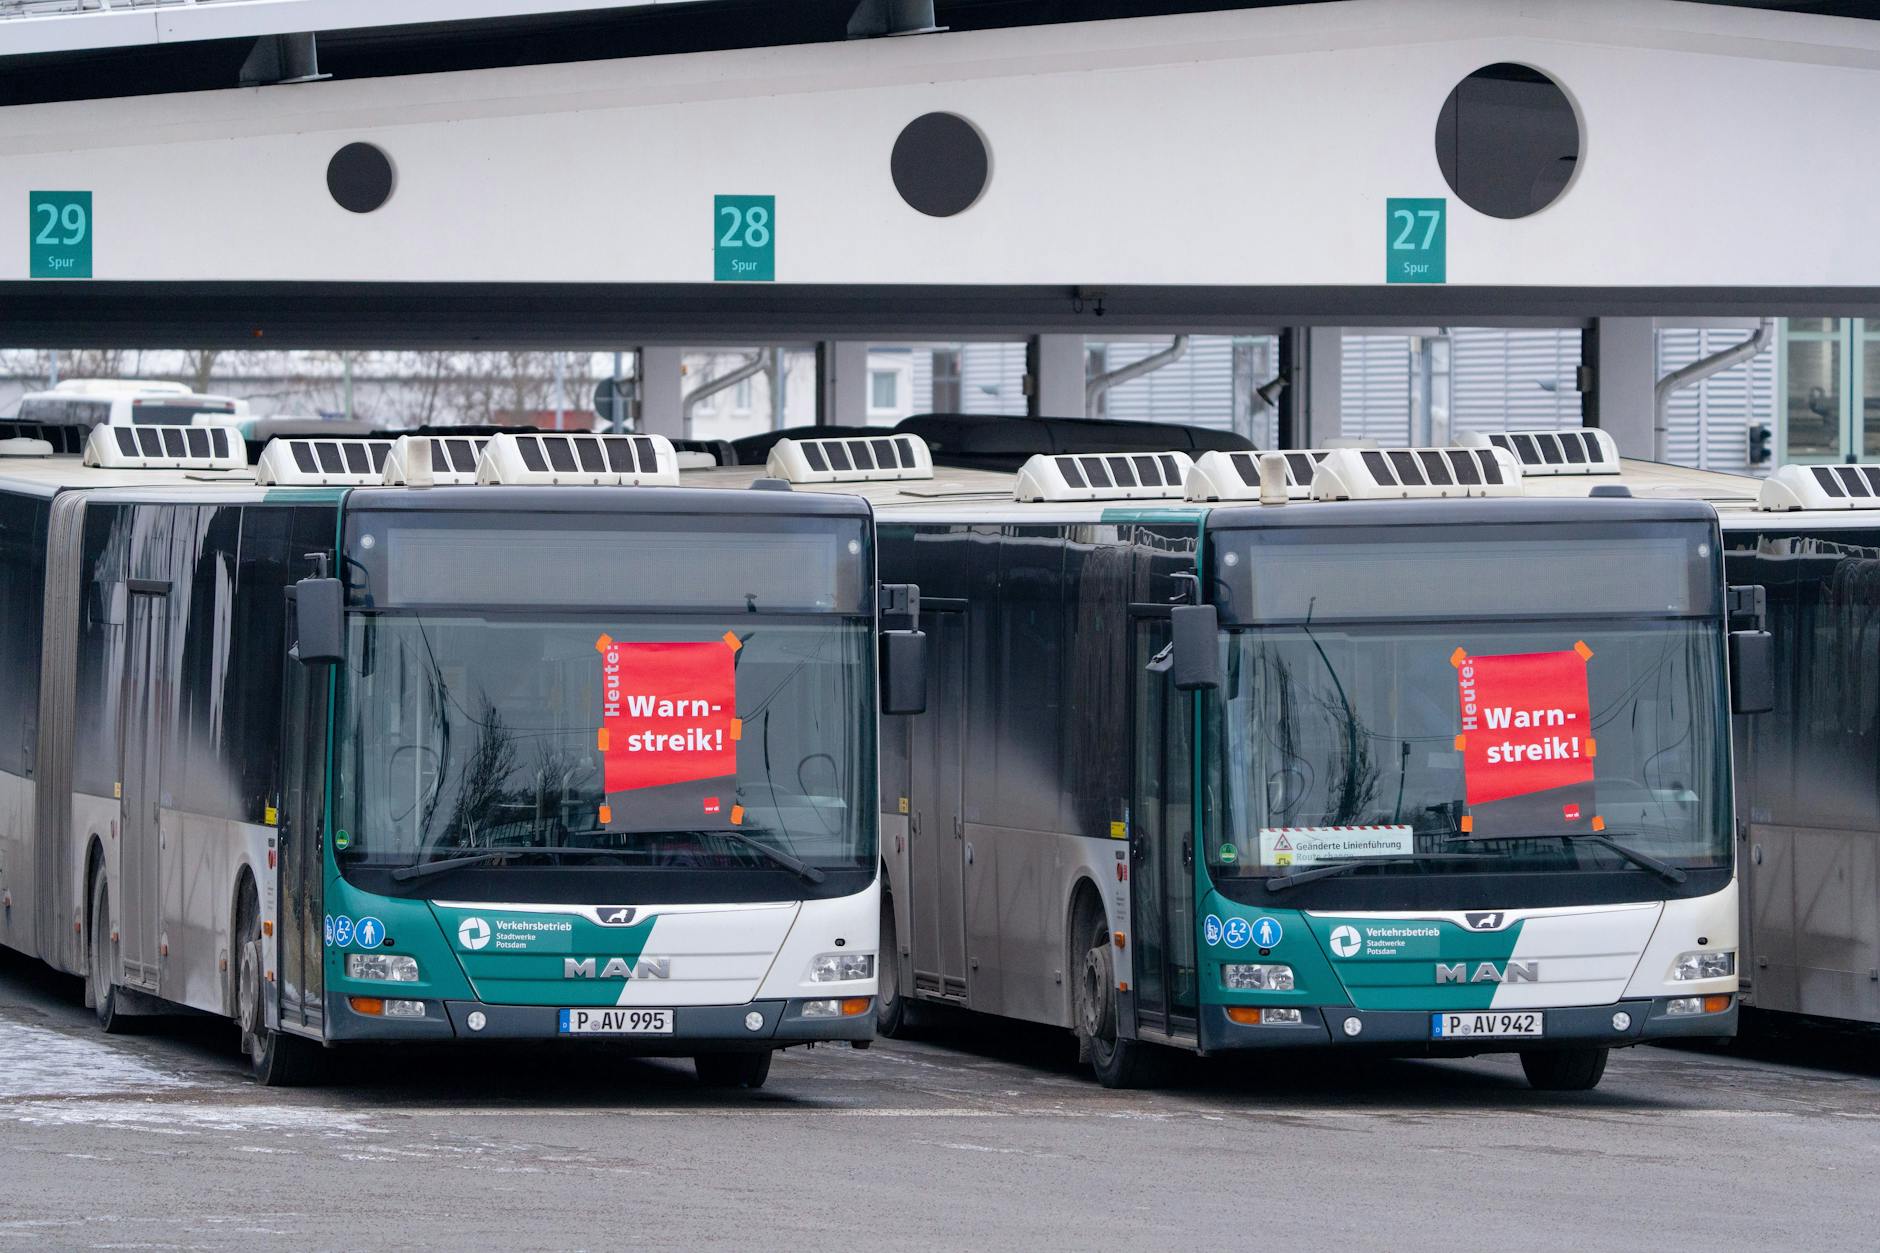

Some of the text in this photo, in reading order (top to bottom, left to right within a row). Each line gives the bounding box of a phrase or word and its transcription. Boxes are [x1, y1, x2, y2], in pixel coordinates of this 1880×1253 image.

[36, 203, 86, 245] 29
[720, 206, 769, 247] 28
[1393, 209, 1440, 250] 27
[48, 256, 74, 270] Spur
[732, 259, 757, 273] Spur
[1404, 262, 1429, 276] Spur
[604, 644, 620, 717] Heute:
[1460, 659, 1478, 731] Heute:
[627, 695, 721, 718] Warn-
[1483, 706, 1577, 730] Warn-
[628, 728, 723, 752] streik!
[1487, 736, 1580, 764] streik!
[1296, 840, 1402, 851] Geänderte Linienführung
[496, 920, 572, 932] Verkehrsbetrieb
[1366, 928, 1440, 937] Verkehrsbetrieb
[496, 932, 537, 941] Stadtwerke
[496, 940, 527, 949] Potsdam
[1366, 939, 1406, 948] Stadtwerke
[1366, 947, 1397, 955] Potsdam
[564, 957, 671, 979] MAN
[1435, 961, 1539, 984] MAN
[577, 1012, 665, 1030] P AV 995
[1450, 1015, 1535, 1034] P AV 942
